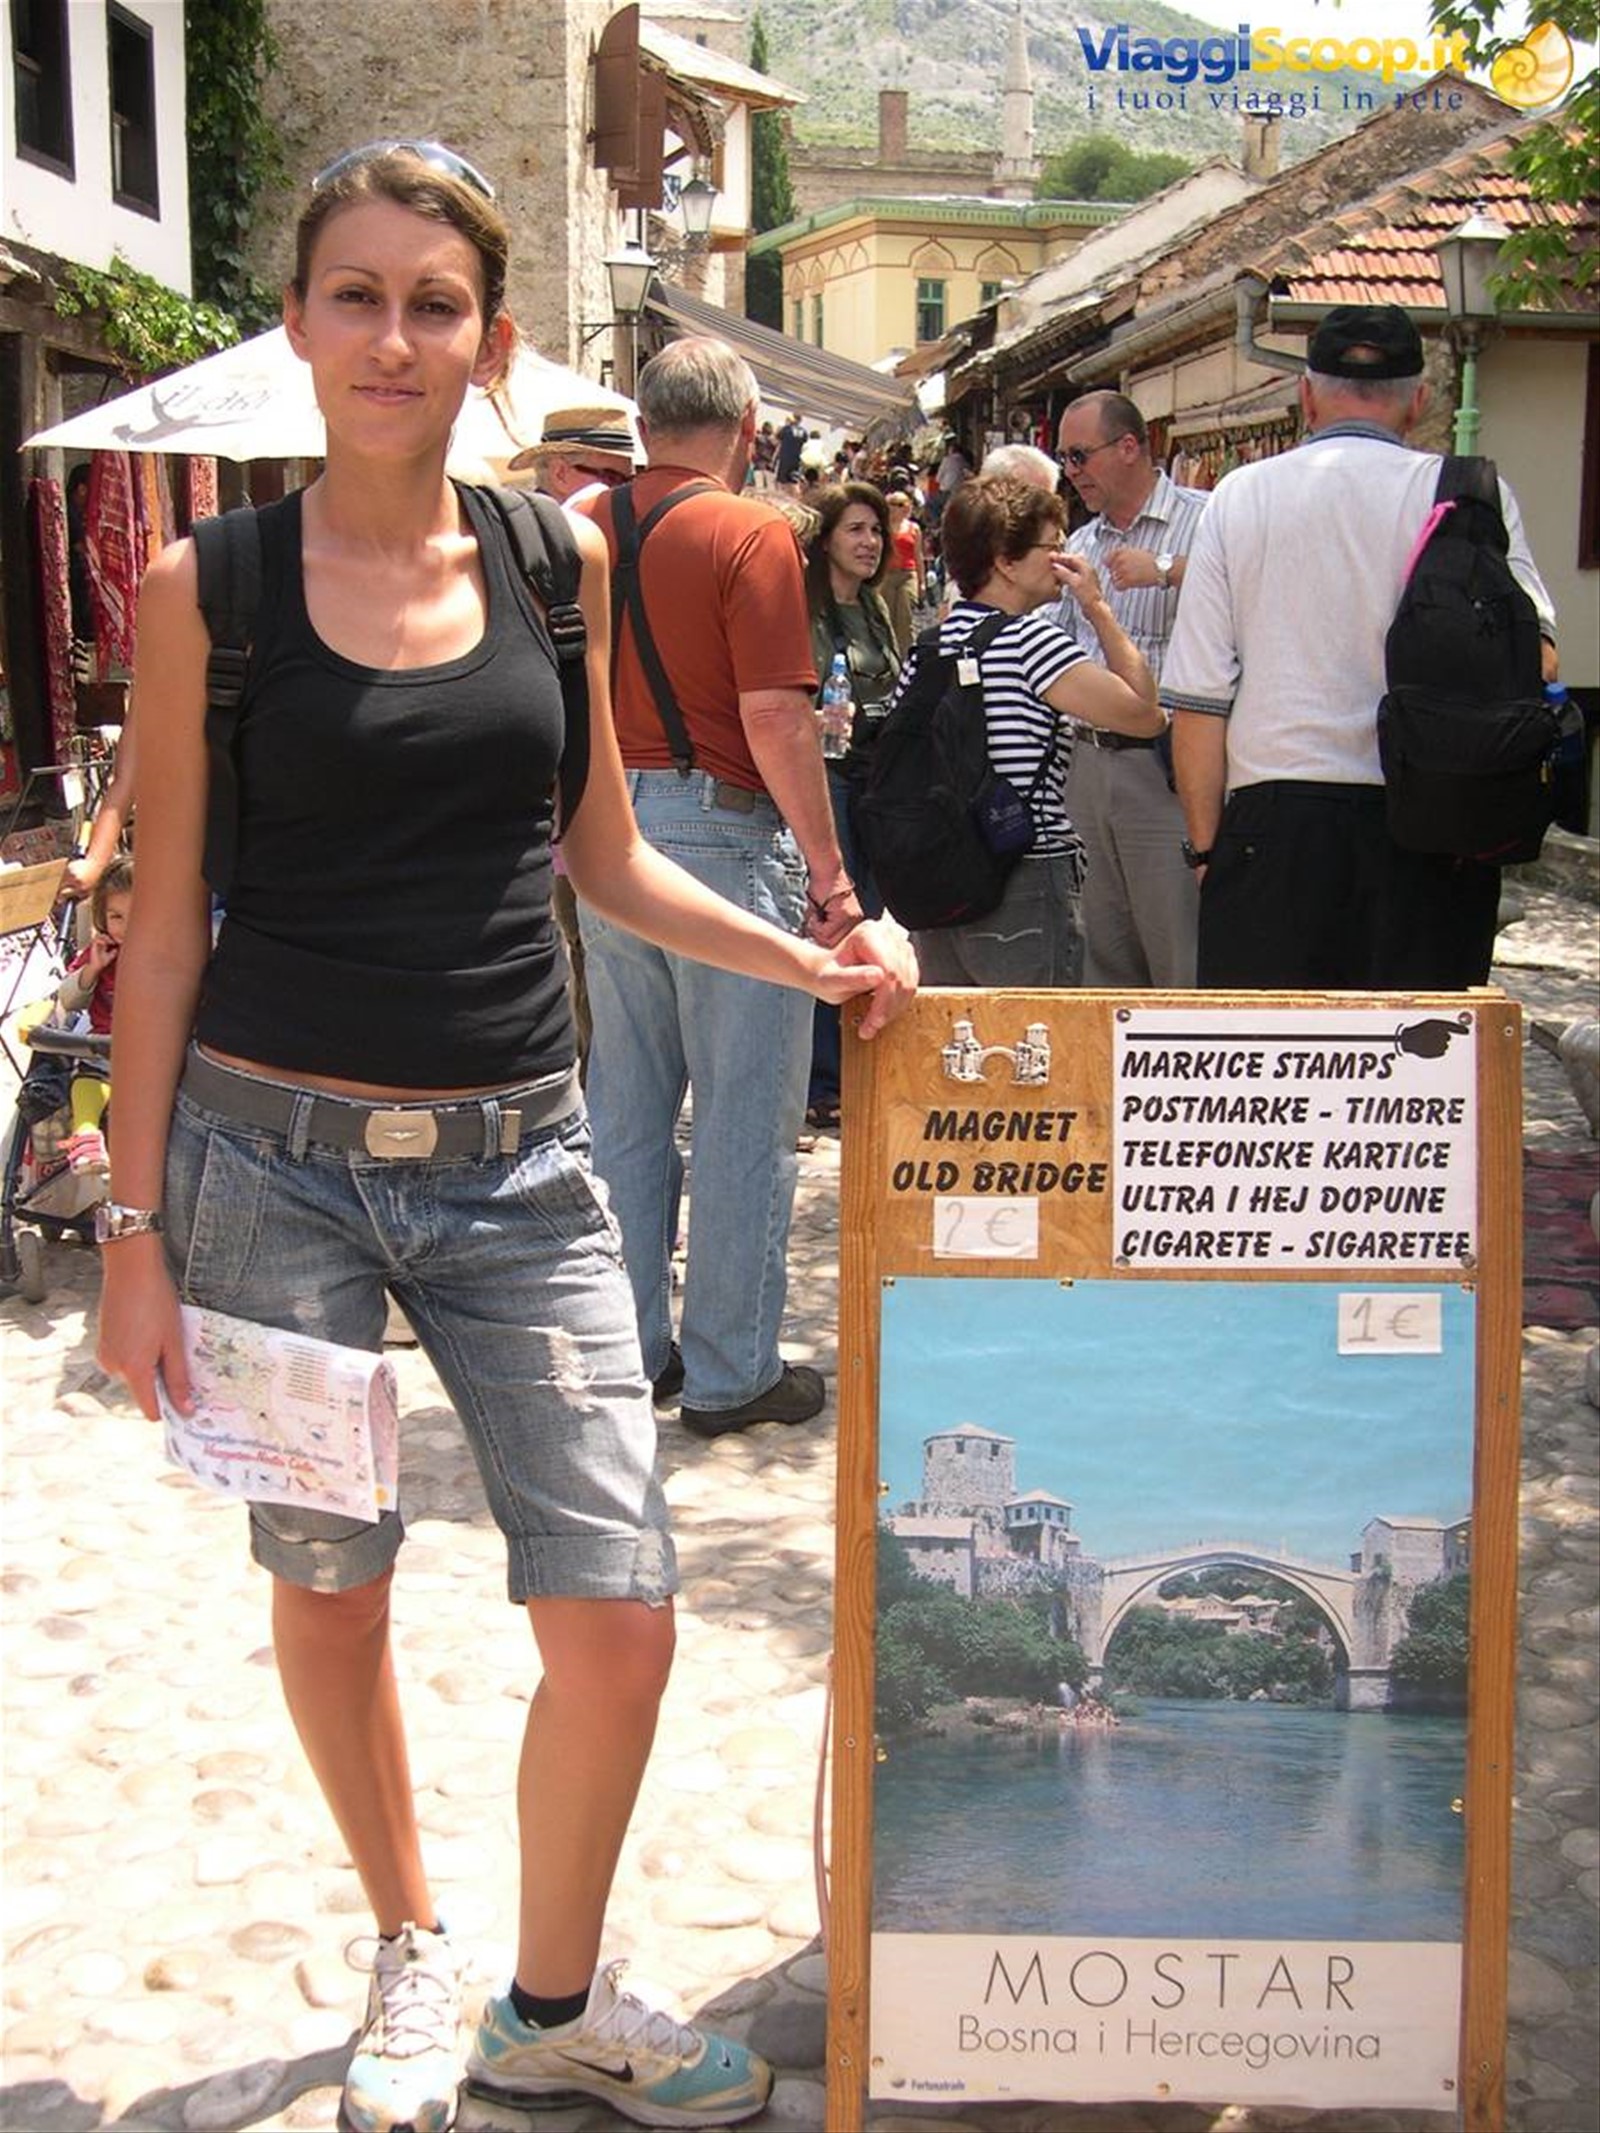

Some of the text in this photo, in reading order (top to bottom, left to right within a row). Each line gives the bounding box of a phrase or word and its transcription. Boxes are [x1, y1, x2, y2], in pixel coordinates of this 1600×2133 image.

[1121, 1051, 1396, 1080] MARKICE STAMPS
[923, 1110, 1077, 1142] MAGNET
[1122, 1096, 1310, 1125] POSTMARKE
[1346, 1097, 1465, 1126] TIMBRE
[1123, 1140, 1451, 1170] TELEFONSKE KARTICE
[892, 1160, 1108, 1194] OLD BRIDGE
[1121, 1185, 1446, 1214] ULTRA I HEJ DOPUNE
[1121, 1230, 1272, 1259] CIGARETE
[1305, 1231, 1470, 1259] SIGARETEE
[983, 1950, 1355, 2010] MOSTAR
[958, 2015, 1381, 2069] Bosna i Hercegovina
